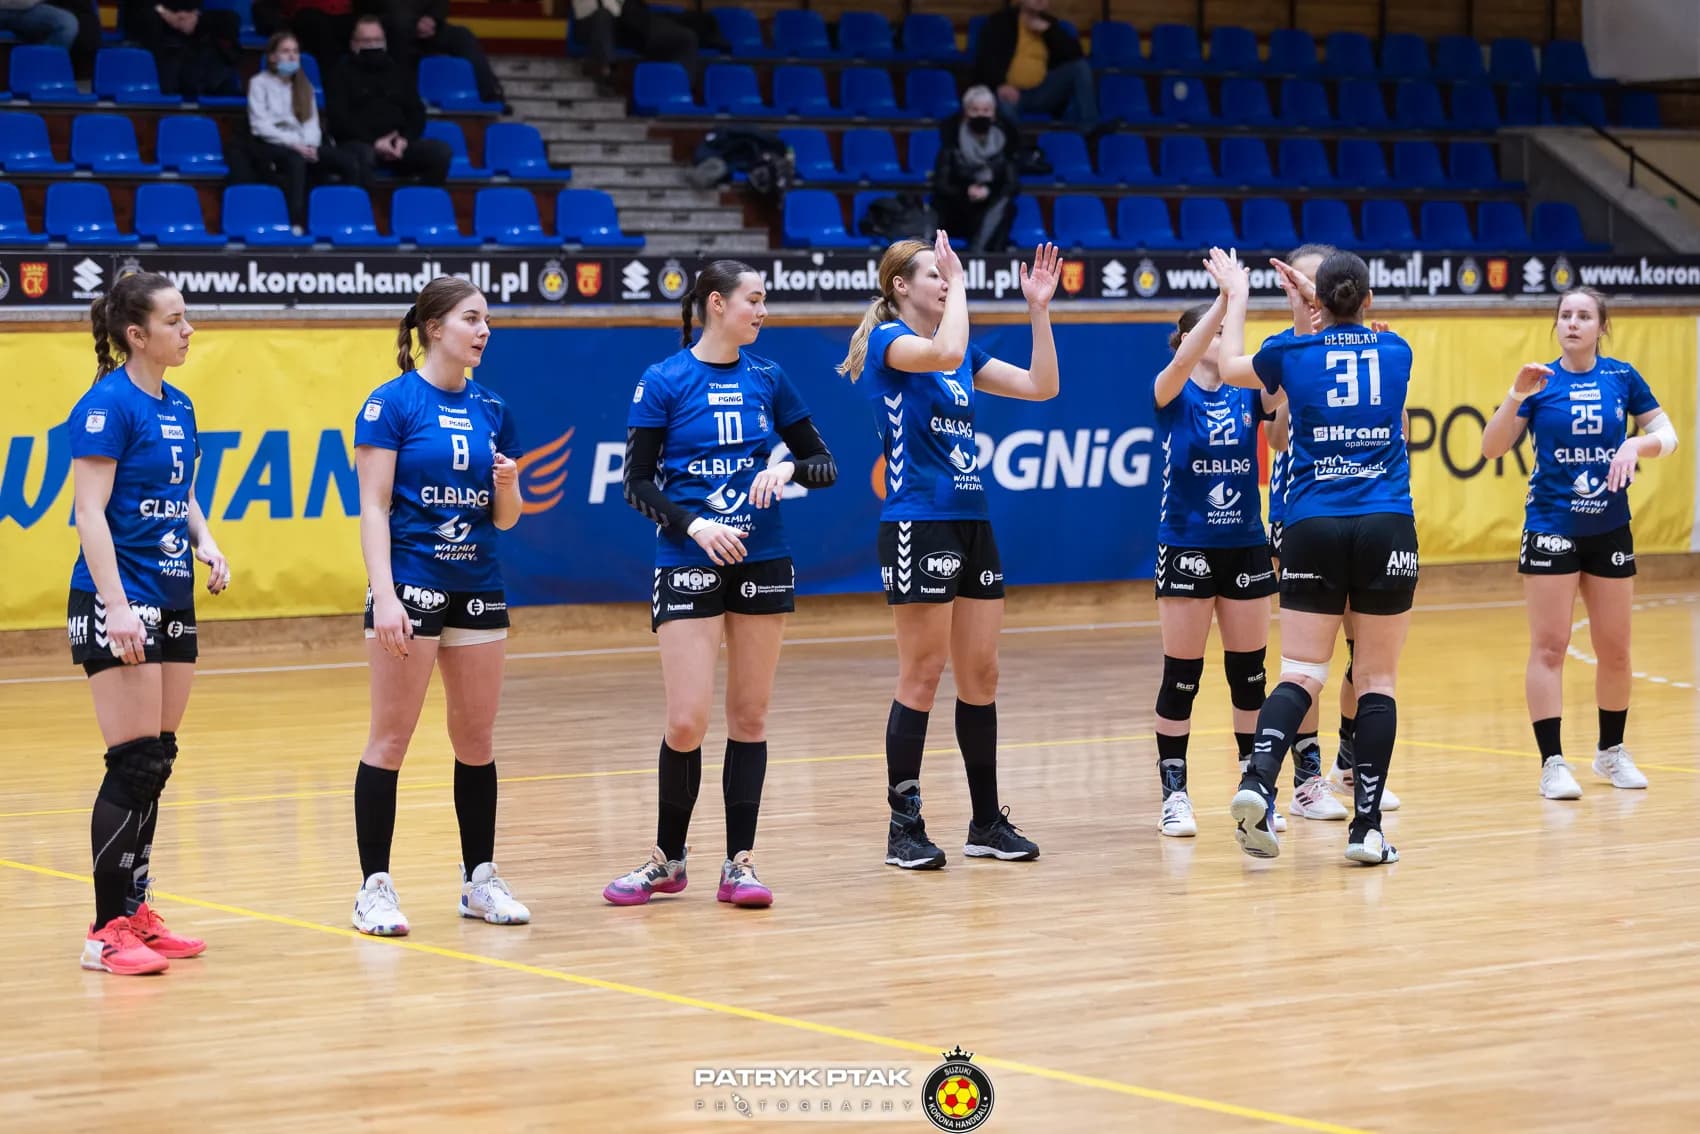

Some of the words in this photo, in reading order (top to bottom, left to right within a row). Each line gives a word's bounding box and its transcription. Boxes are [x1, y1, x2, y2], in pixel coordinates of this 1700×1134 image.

[158, 261, 529, 302] www.koronahandll.pl
[1325, 348, 1382, 408] 31
[713, 411, 744, 446] 10
[1570, 404, 1604, 435] 25
[1207, 417, 1239, 446] 22
[1330, 425, 1390, 440] Kram
[451, 434, 470, 471] 8
[169, 445, 185, 485] 5
[434, 543, 477, 552] WARMIA
[927, 557, 961, 573] MOP
[1386, 550, 1417, 570] AMH
[673, 572, 717, 587] MOP
[920, 585, 946, 594] hummel
[403, 584, 446, 606] MOP
[68, 615, 88, 637] MH
